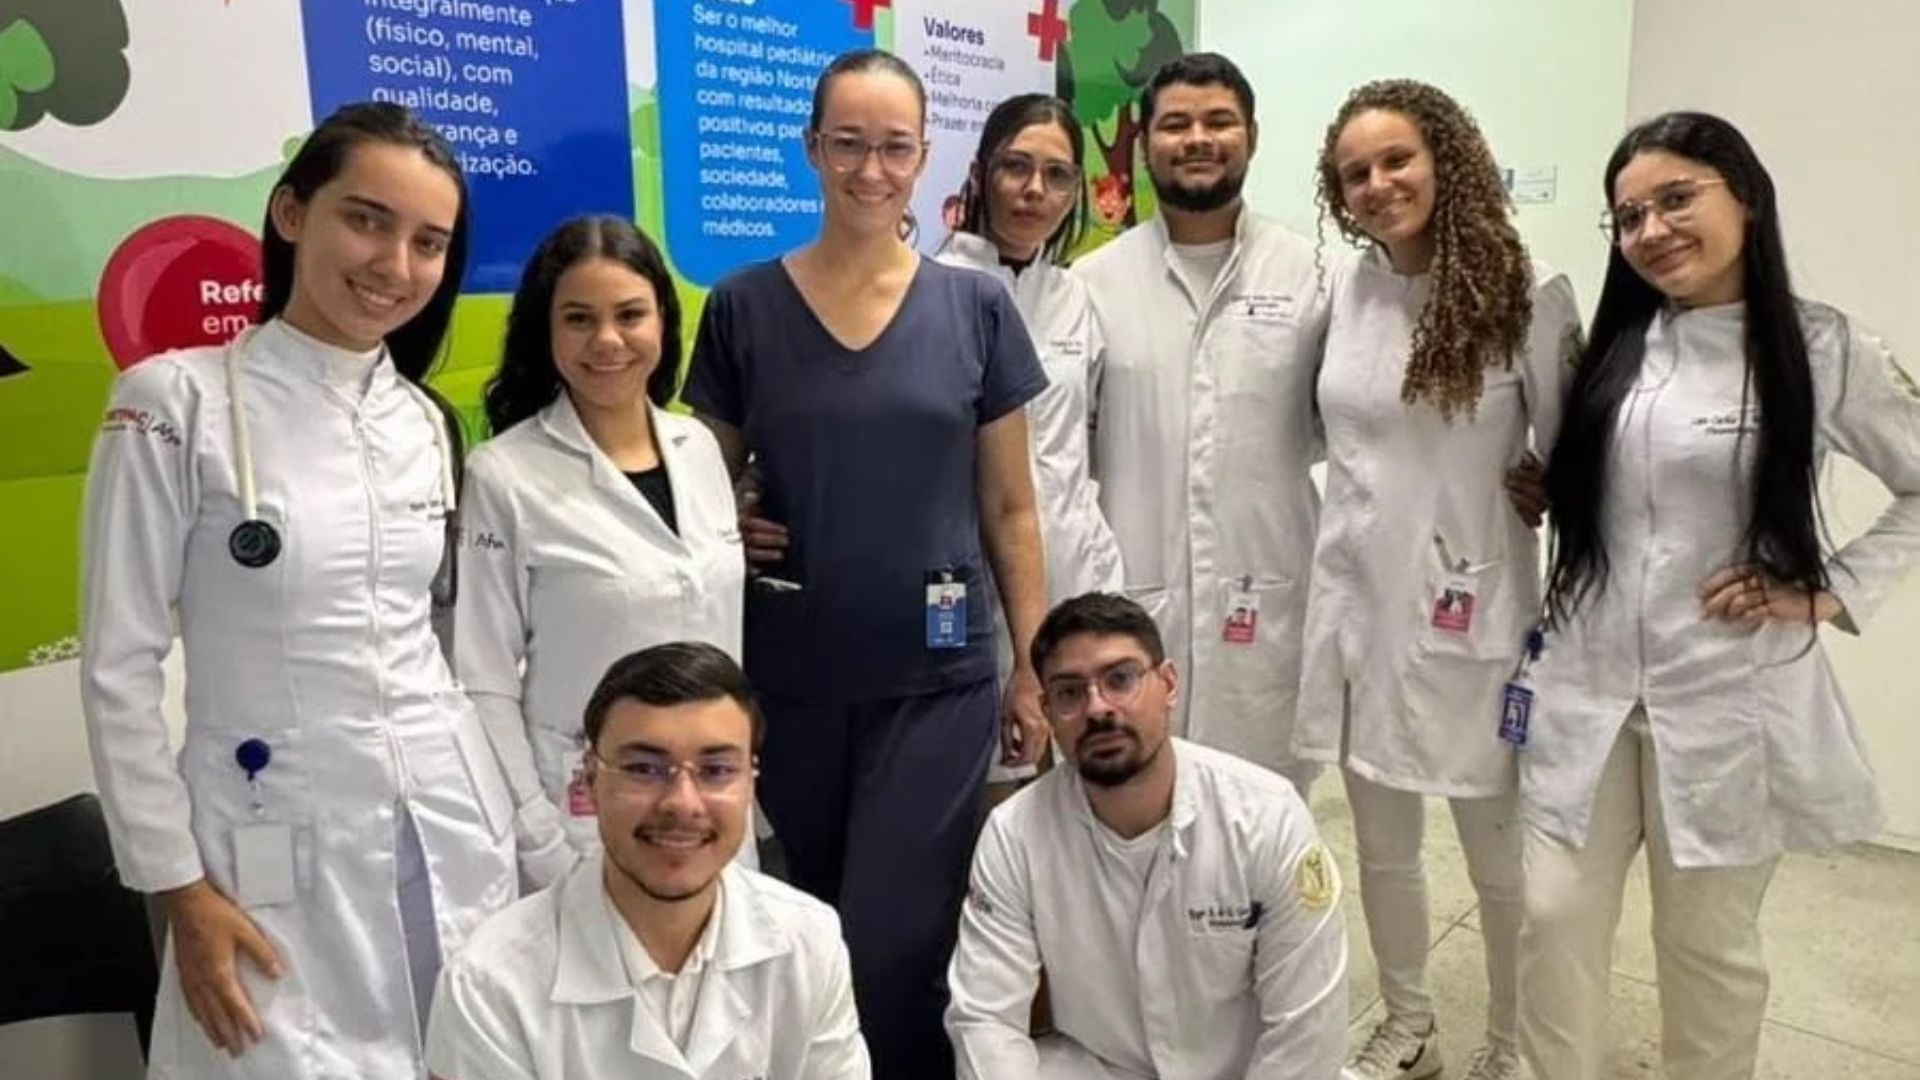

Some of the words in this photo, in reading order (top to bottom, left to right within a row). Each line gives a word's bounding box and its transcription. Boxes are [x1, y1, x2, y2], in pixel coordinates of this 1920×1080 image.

[692, 3, 722, 25] Ser
[726, 13, 738, 29] o
[741, 14, 799, 38] melhor
[923, 16, 985, 46] Valores
[366, 15, 450, 50] (físico,
[456, 31, 539, 60] mental,
[694, 32, 764, 58] hospital
[369, 54, 457, 83] social),
[462, 64, 513, 85] com
[695, 60, 718, 80] da
[721, 64, 774, 88] região
[696, 88, 735, 106] com
[738, 94, 813, 116] resultado
[504, 128, 518, 145] e
[699, 115, 775, 137] positivos
[778, 122, 804, 143] par
[700, 142, 784, 163] pacientes,
[700, 166, 790, 189] sociedade,
[702, 193, 819, 214] colaboradores
[703, 216, 777, 237] médicos.
[202, 315, 249, 335] em
